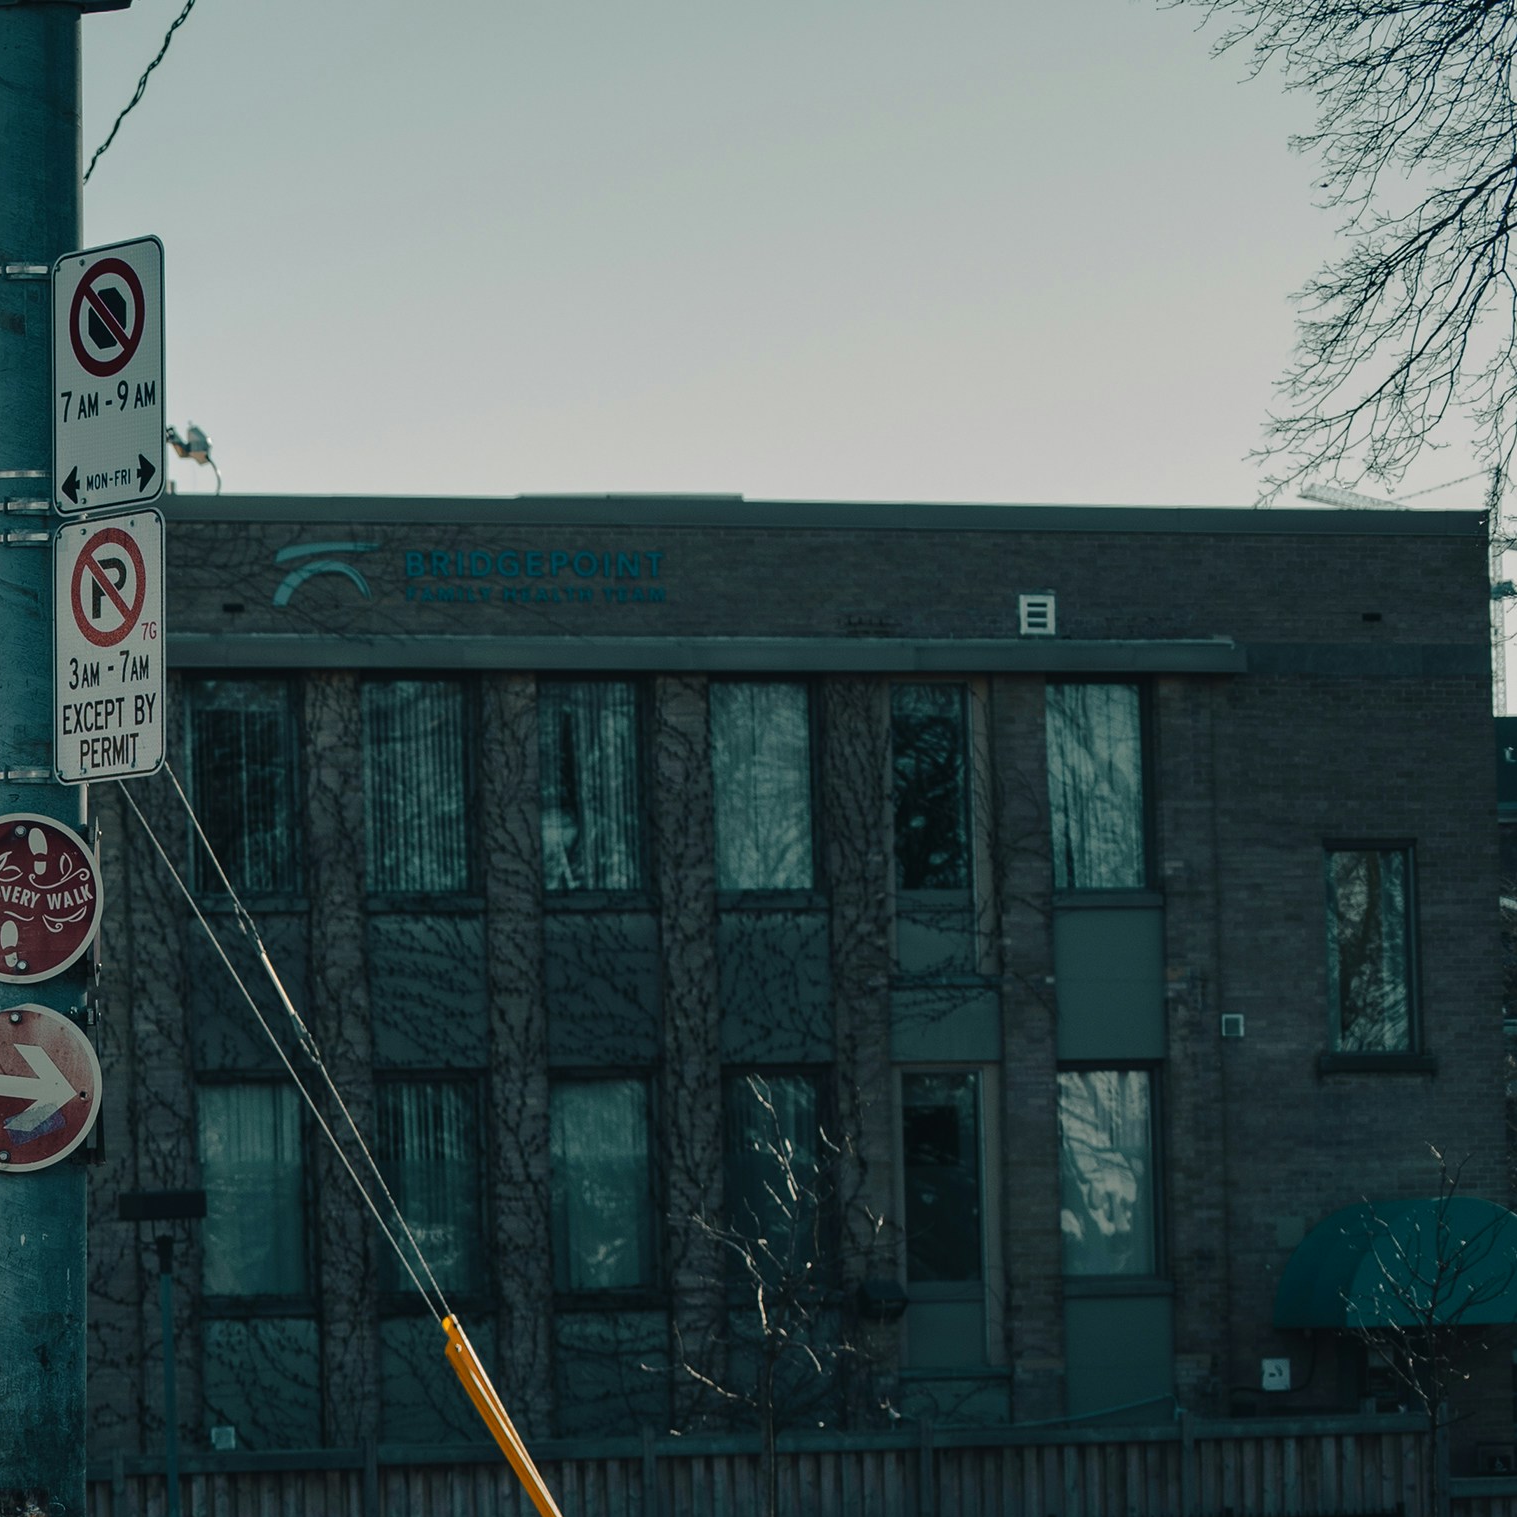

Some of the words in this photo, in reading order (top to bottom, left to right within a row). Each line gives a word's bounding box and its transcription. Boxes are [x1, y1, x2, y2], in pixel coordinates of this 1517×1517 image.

[61, 391, 72, 423] 7
[77, 392, 99, 420] AM
[117, 380, 129, 411] 9
[134, 381, 156, 409] AM
[86, 468, 131, 492] MON-FRI
[405, 550, 664, 579] BRIDGEPOINT
[405, 586, 491, 606] FAMILY
[502, 586, 594, 606] HEALTH
[602, 586, 667, 606] TEAM
[141, 621, 157, 641] 7G
[69, 657, 100, 690] 3AM
[119, 650, 150, 683] 7AM
[62, 697, 126, 736] EXCEPT
[134, 693, 157, 726] BY
[80, 733, 139, 769] PERMIT
[46, 884, 94, 911] WALK
